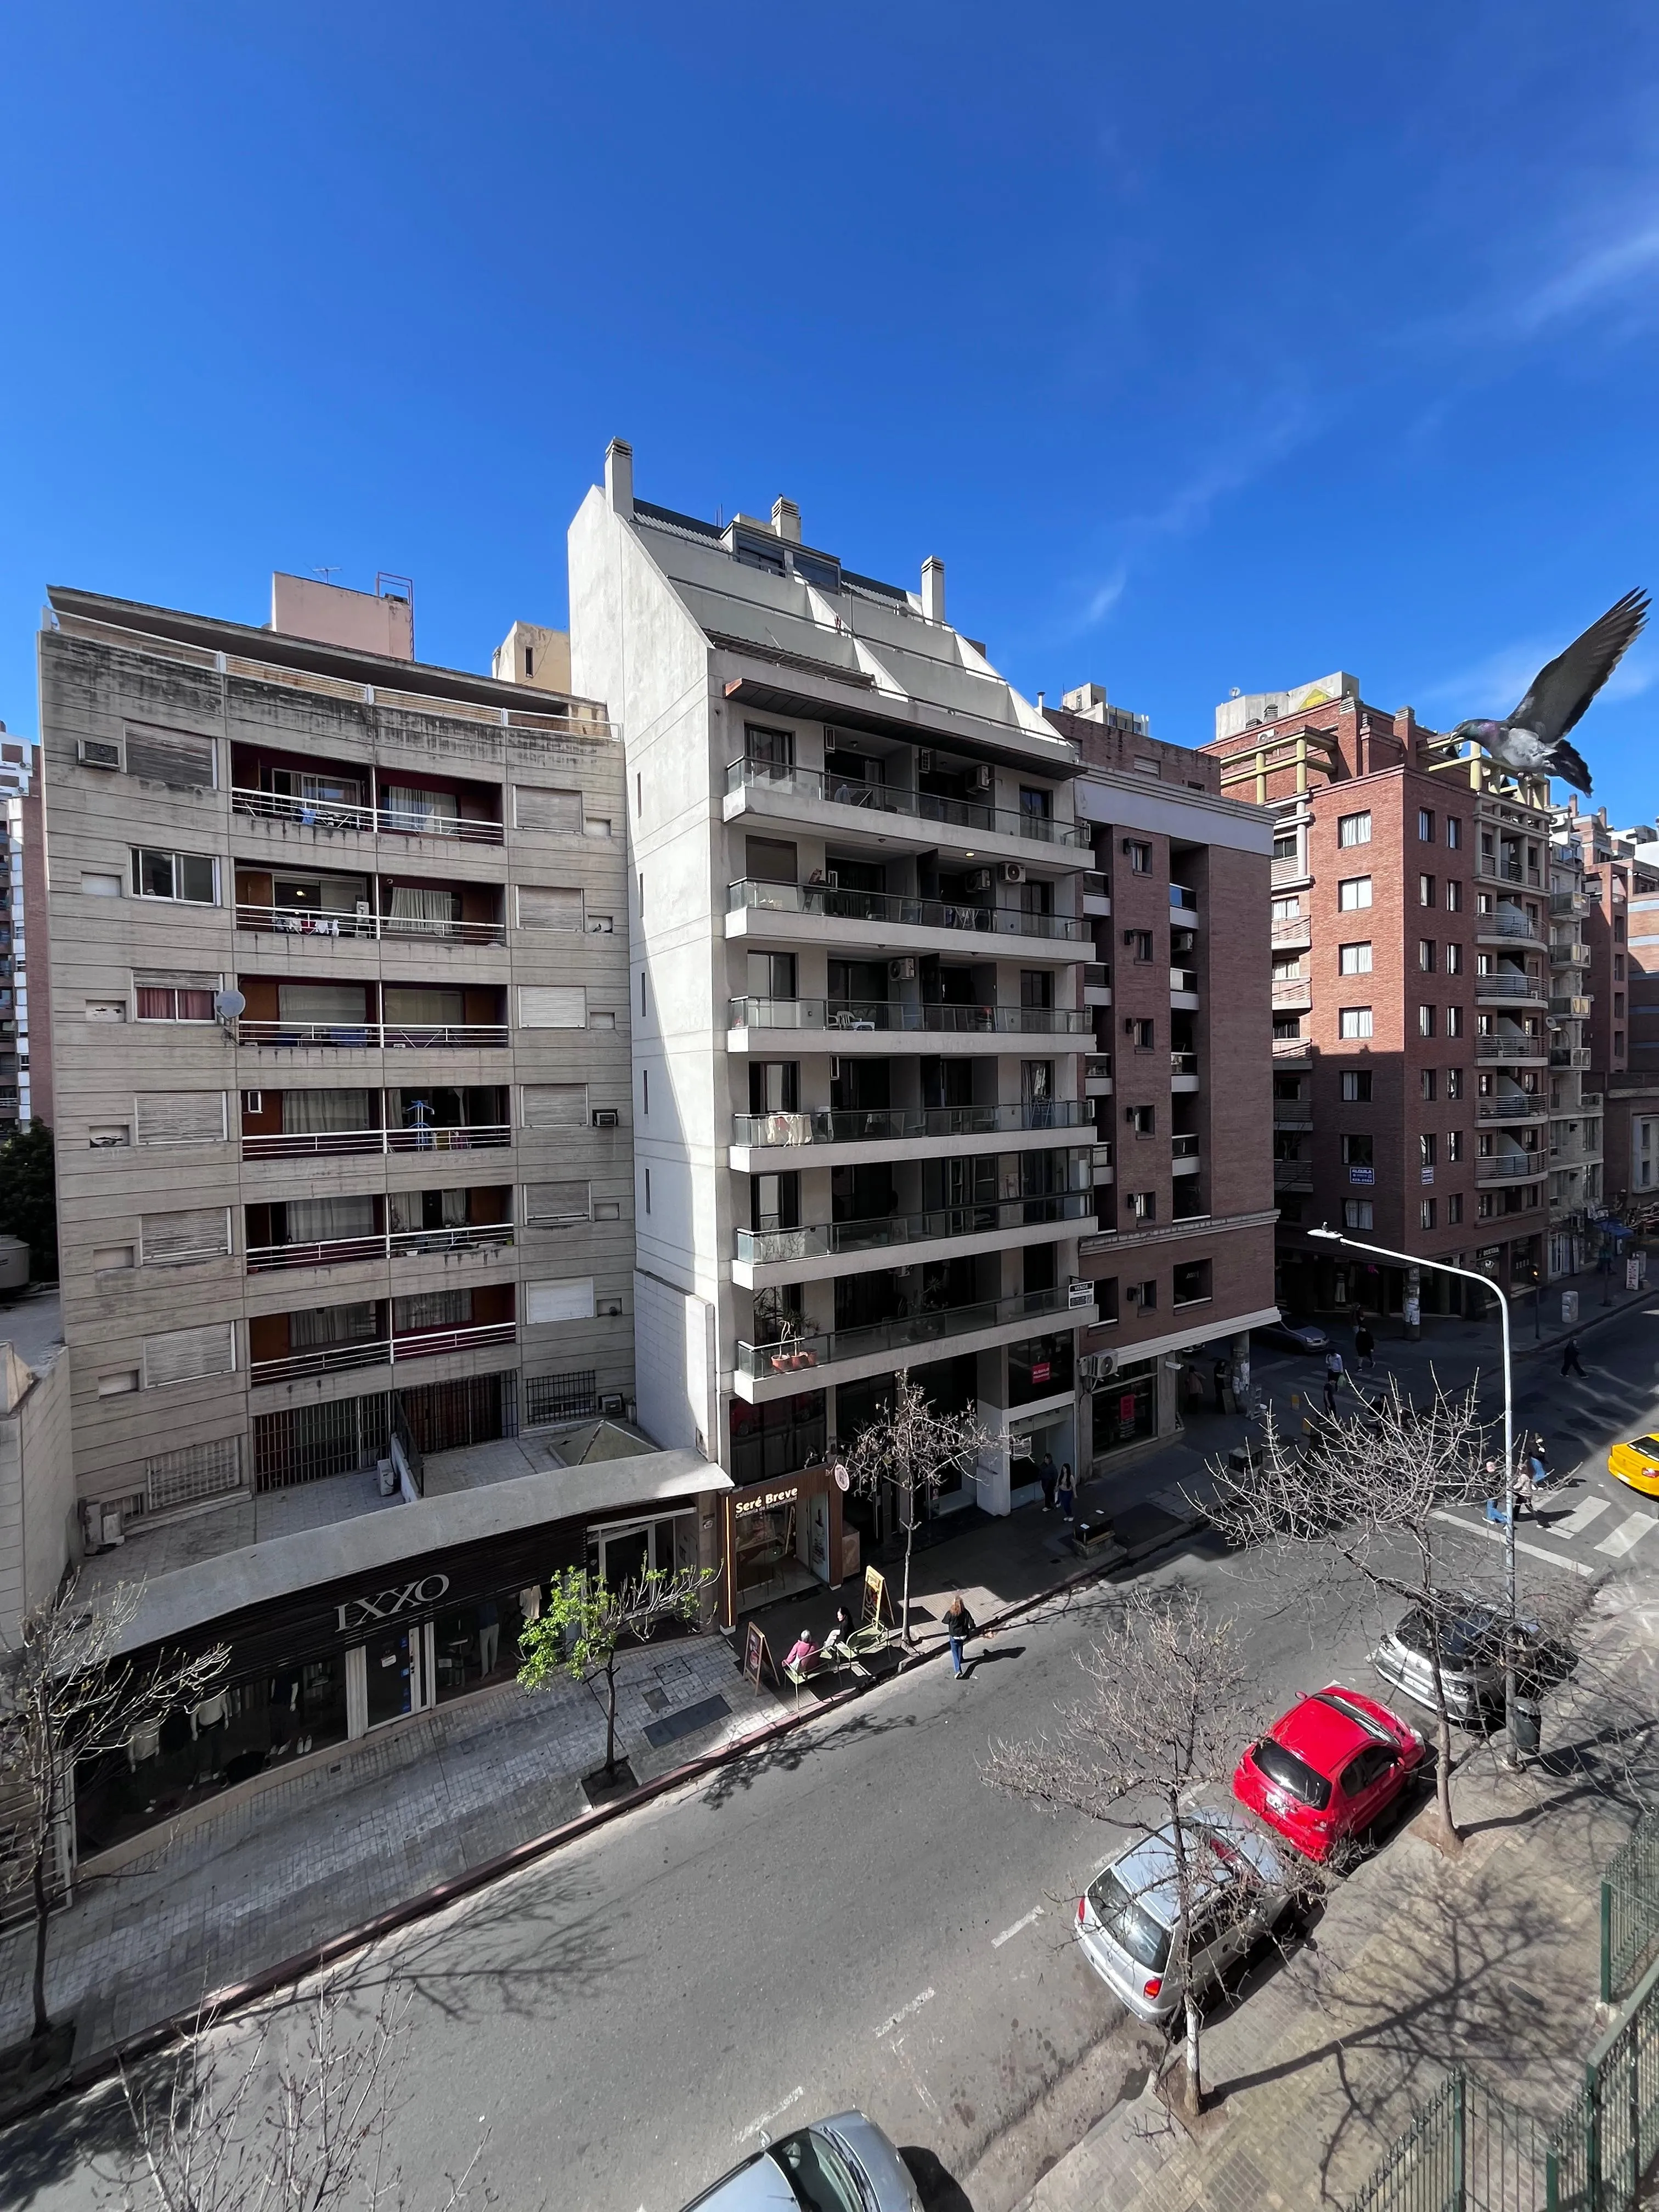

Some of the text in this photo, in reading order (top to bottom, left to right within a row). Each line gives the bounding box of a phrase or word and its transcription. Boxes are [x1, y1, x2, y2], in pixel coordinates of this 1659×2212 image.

[735, 1487, 798, 1514] Seré Breve
[334, 1574, 450, 1633] IXXO
